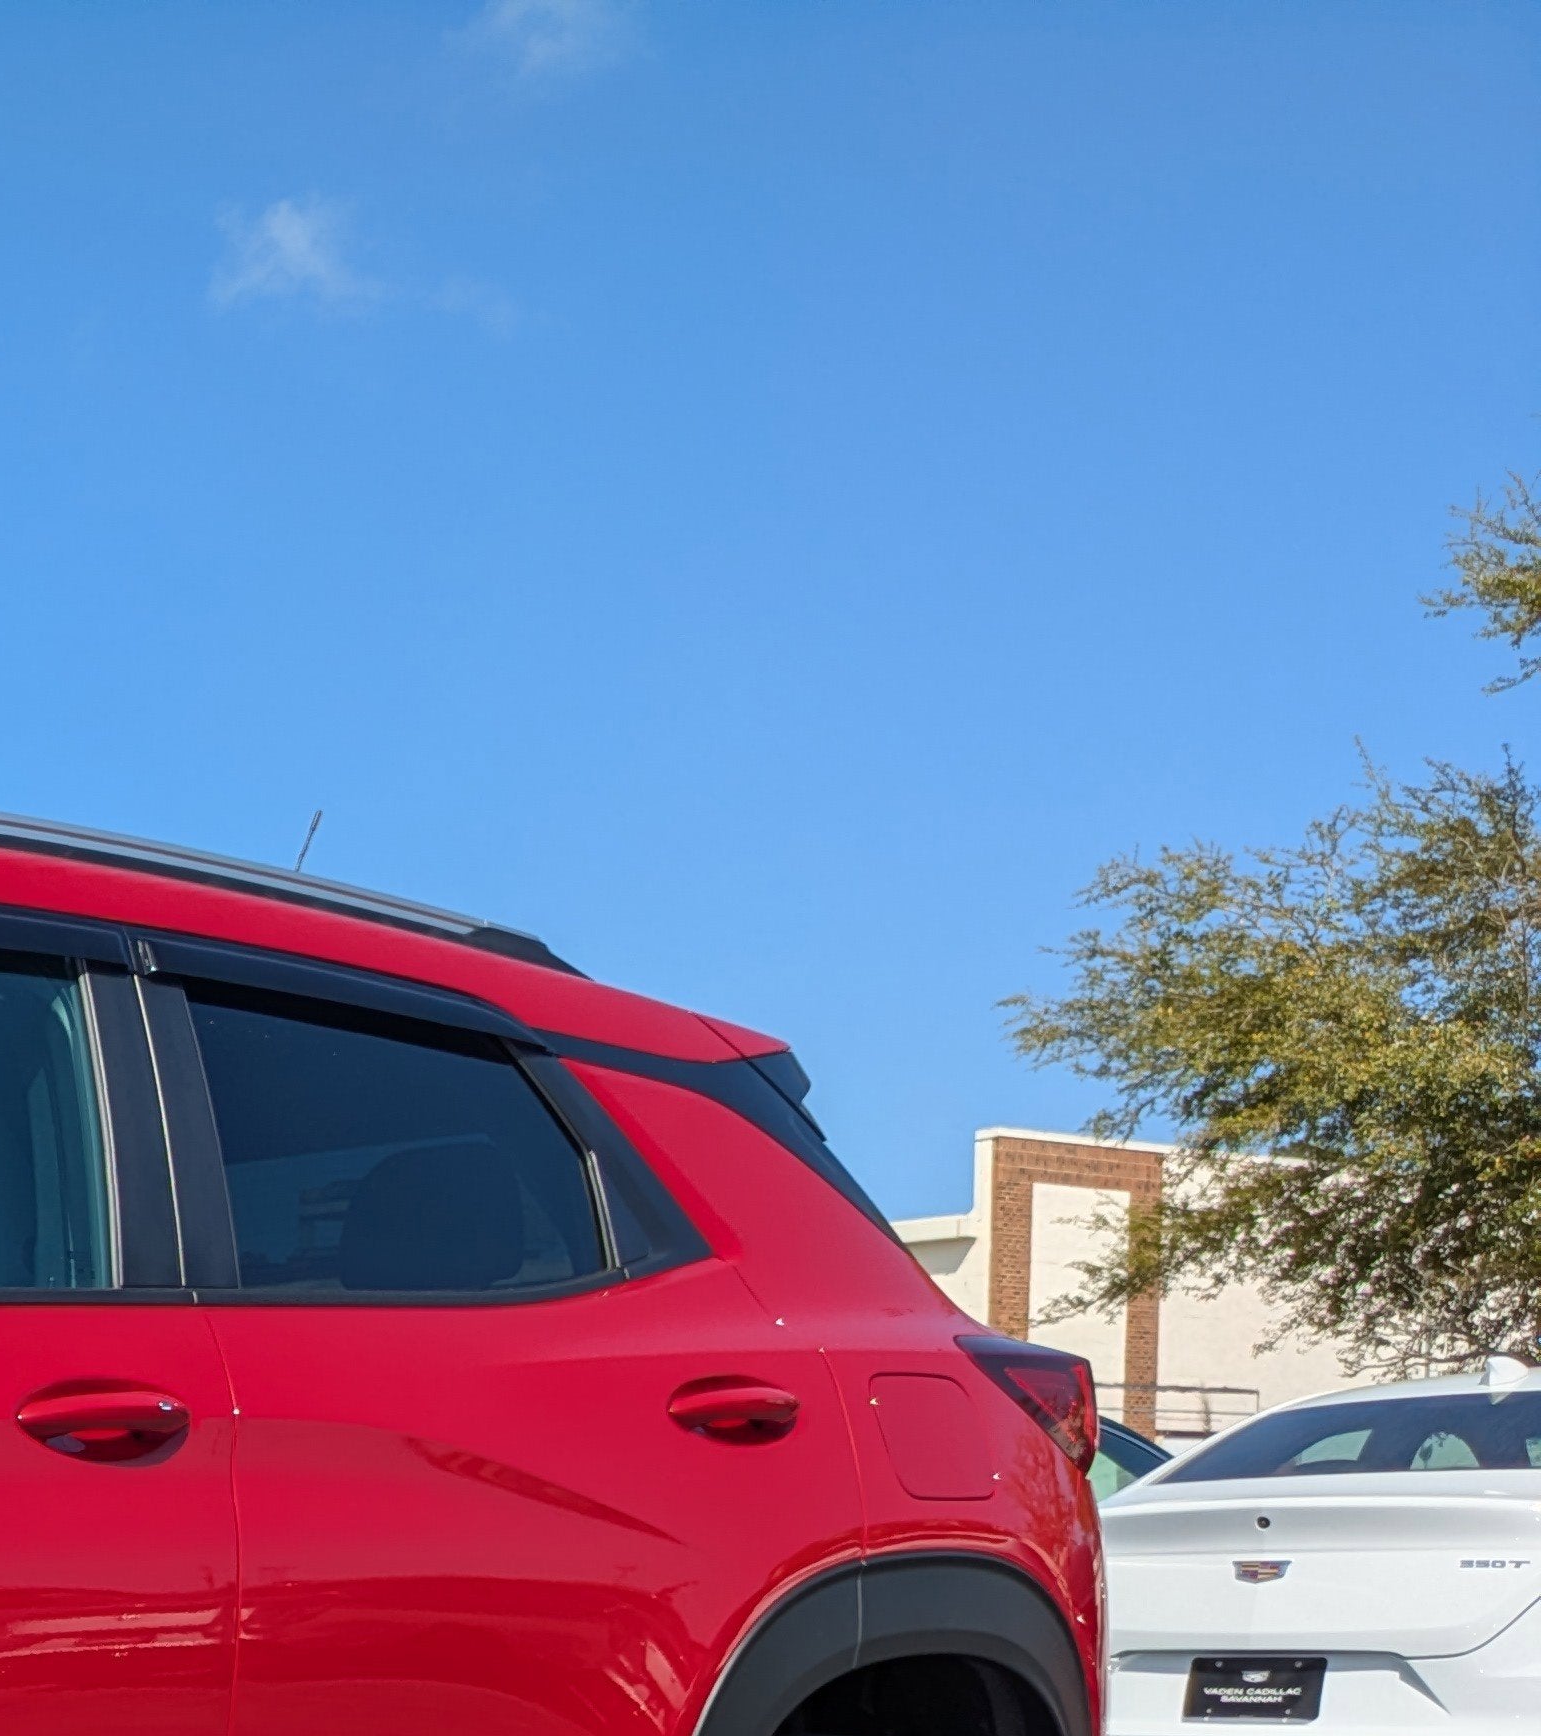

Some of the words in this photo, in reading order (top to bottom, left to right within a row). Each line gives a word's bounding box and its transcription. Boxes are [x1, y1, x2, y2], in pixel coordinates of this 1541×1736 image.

[1203, 1686, 1245, 1696] VADEN
[1246, 1686, 1302, 1697] CADILLAC
[1219, 1695, 1283, 1704] SAVANNAH
